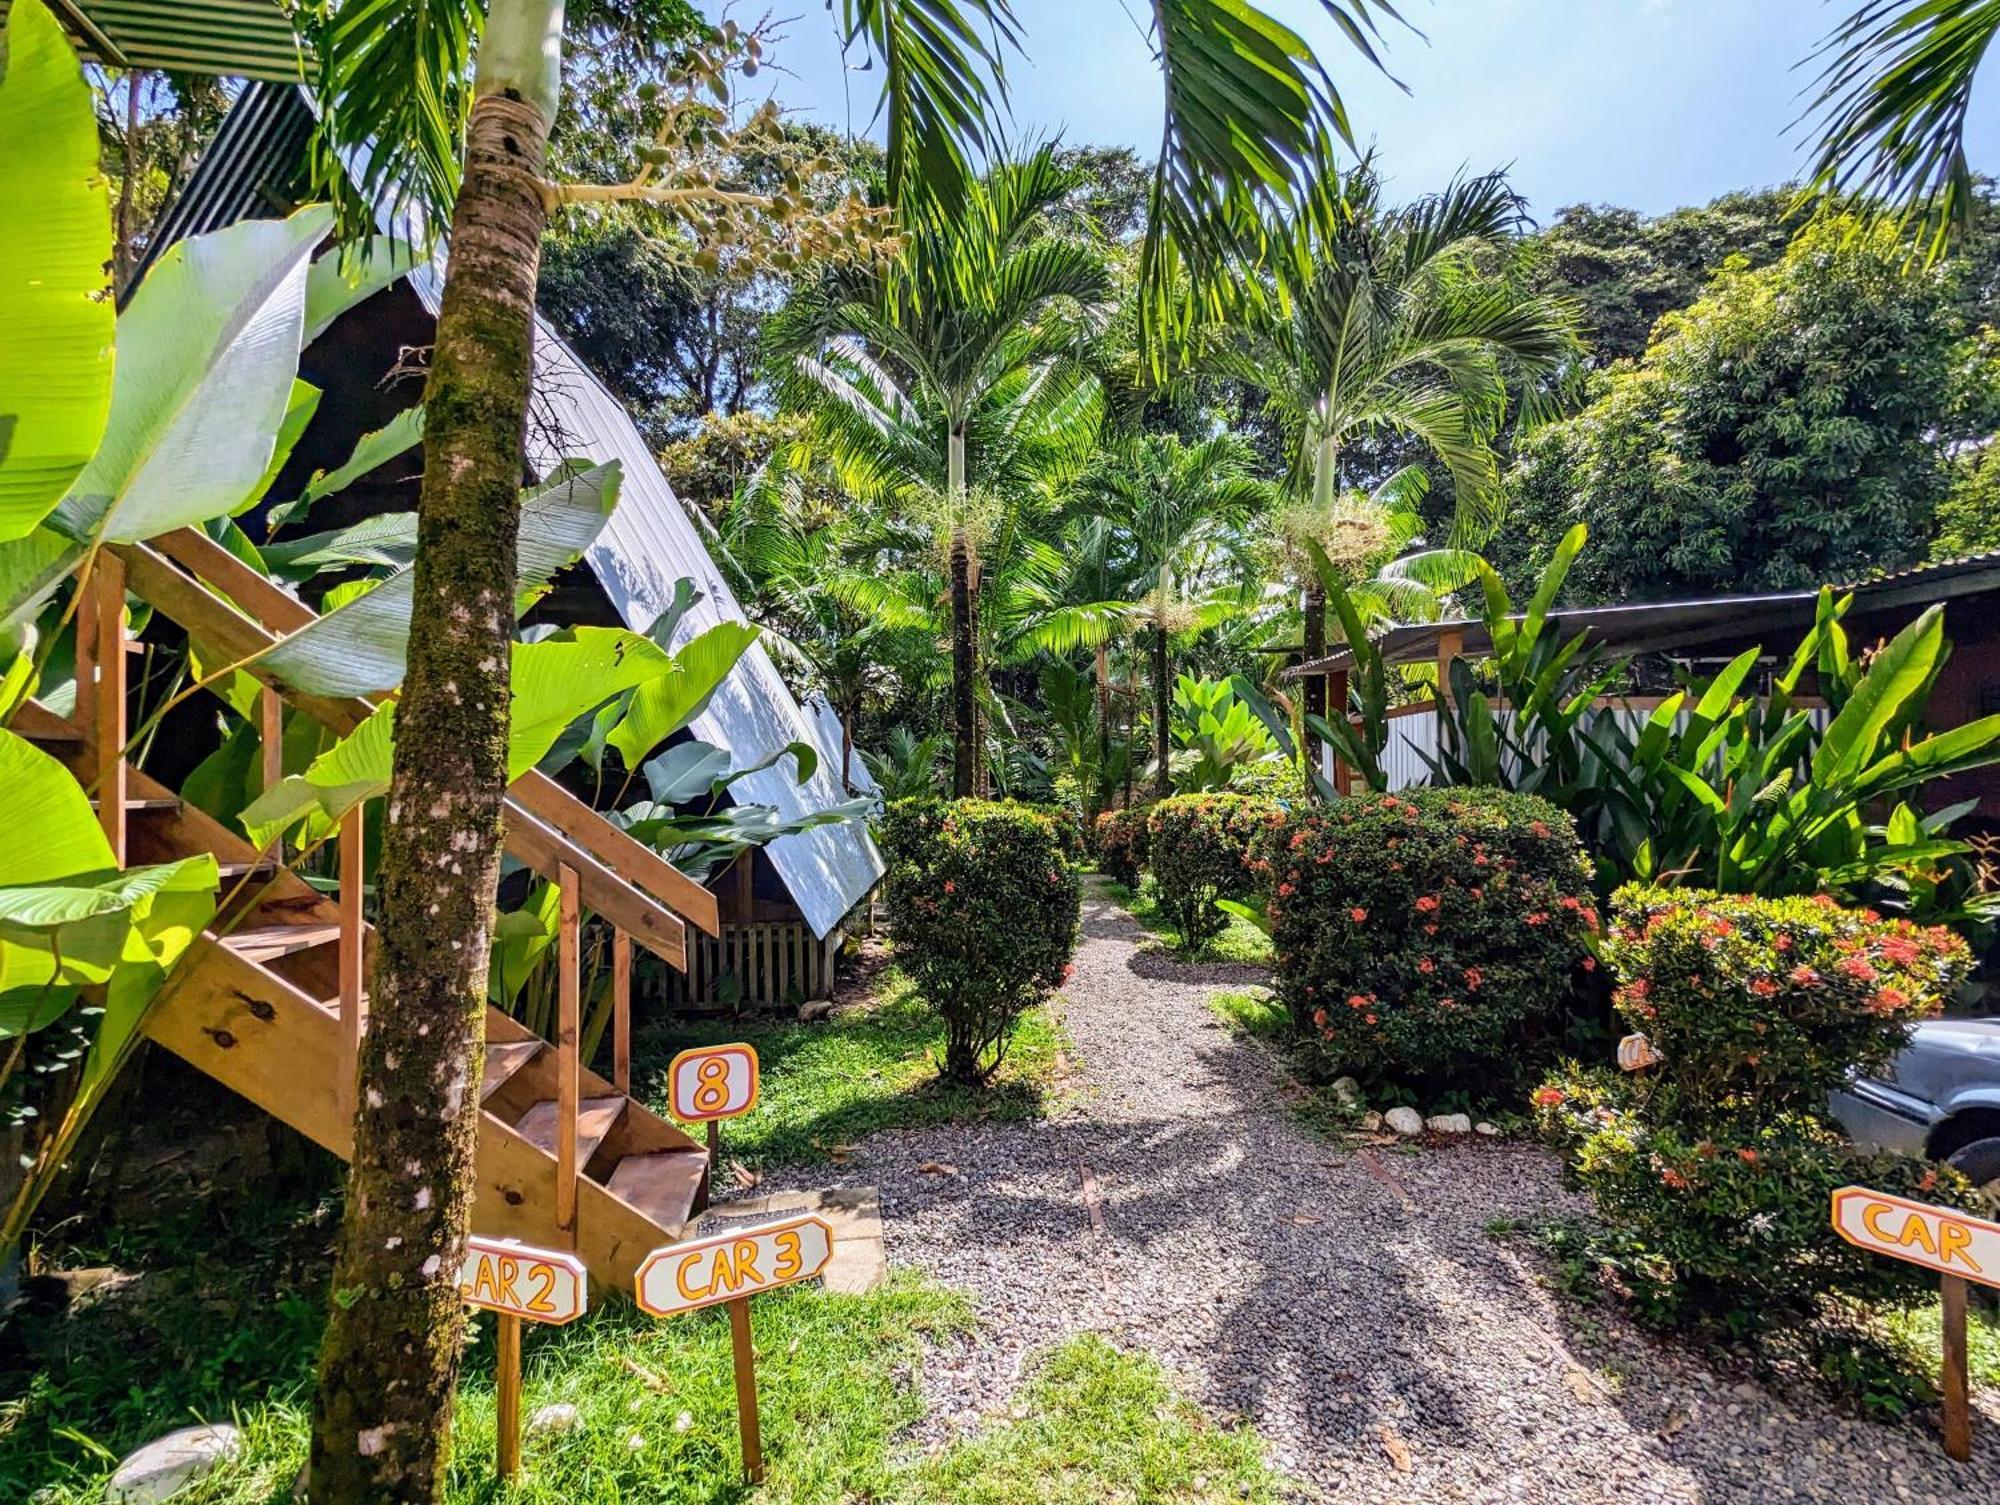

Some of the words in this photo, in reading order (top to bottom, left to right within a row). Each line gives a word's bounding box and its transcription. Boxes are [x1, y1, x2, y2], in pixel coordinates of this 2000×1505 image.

[693, 1057, 729, 1112] 8
[677, 1239, 766, 1301] CAR
[773, 1231, 803, 1280] 3
[1862, 1203, 1983, 1273] CAR
[526, 1263, 556, 1312] 2
